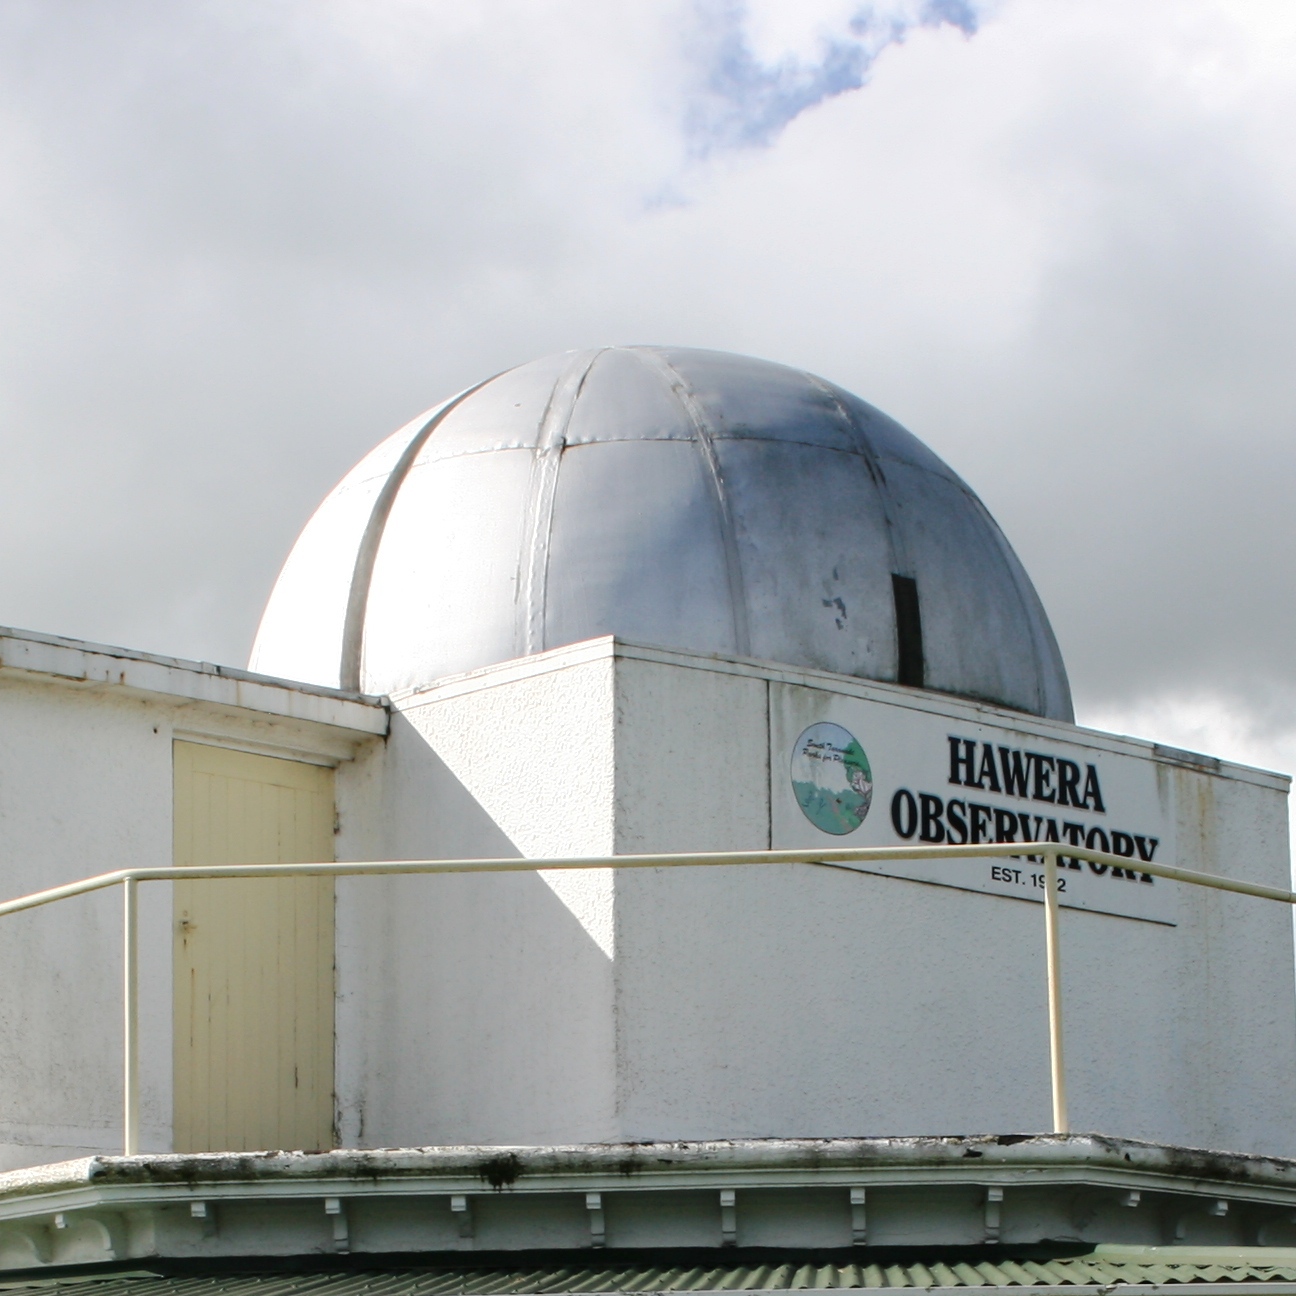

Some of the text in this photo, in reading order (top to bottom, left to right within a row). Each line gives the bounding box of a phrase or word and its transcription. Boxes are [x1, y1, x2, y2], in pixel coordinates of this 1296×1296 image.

[947, 736, 1106, 813] HAWERA
[891, 789, 1159, 884] OBSERVATORY
[992, 866, 1067, 893] EST. 192
